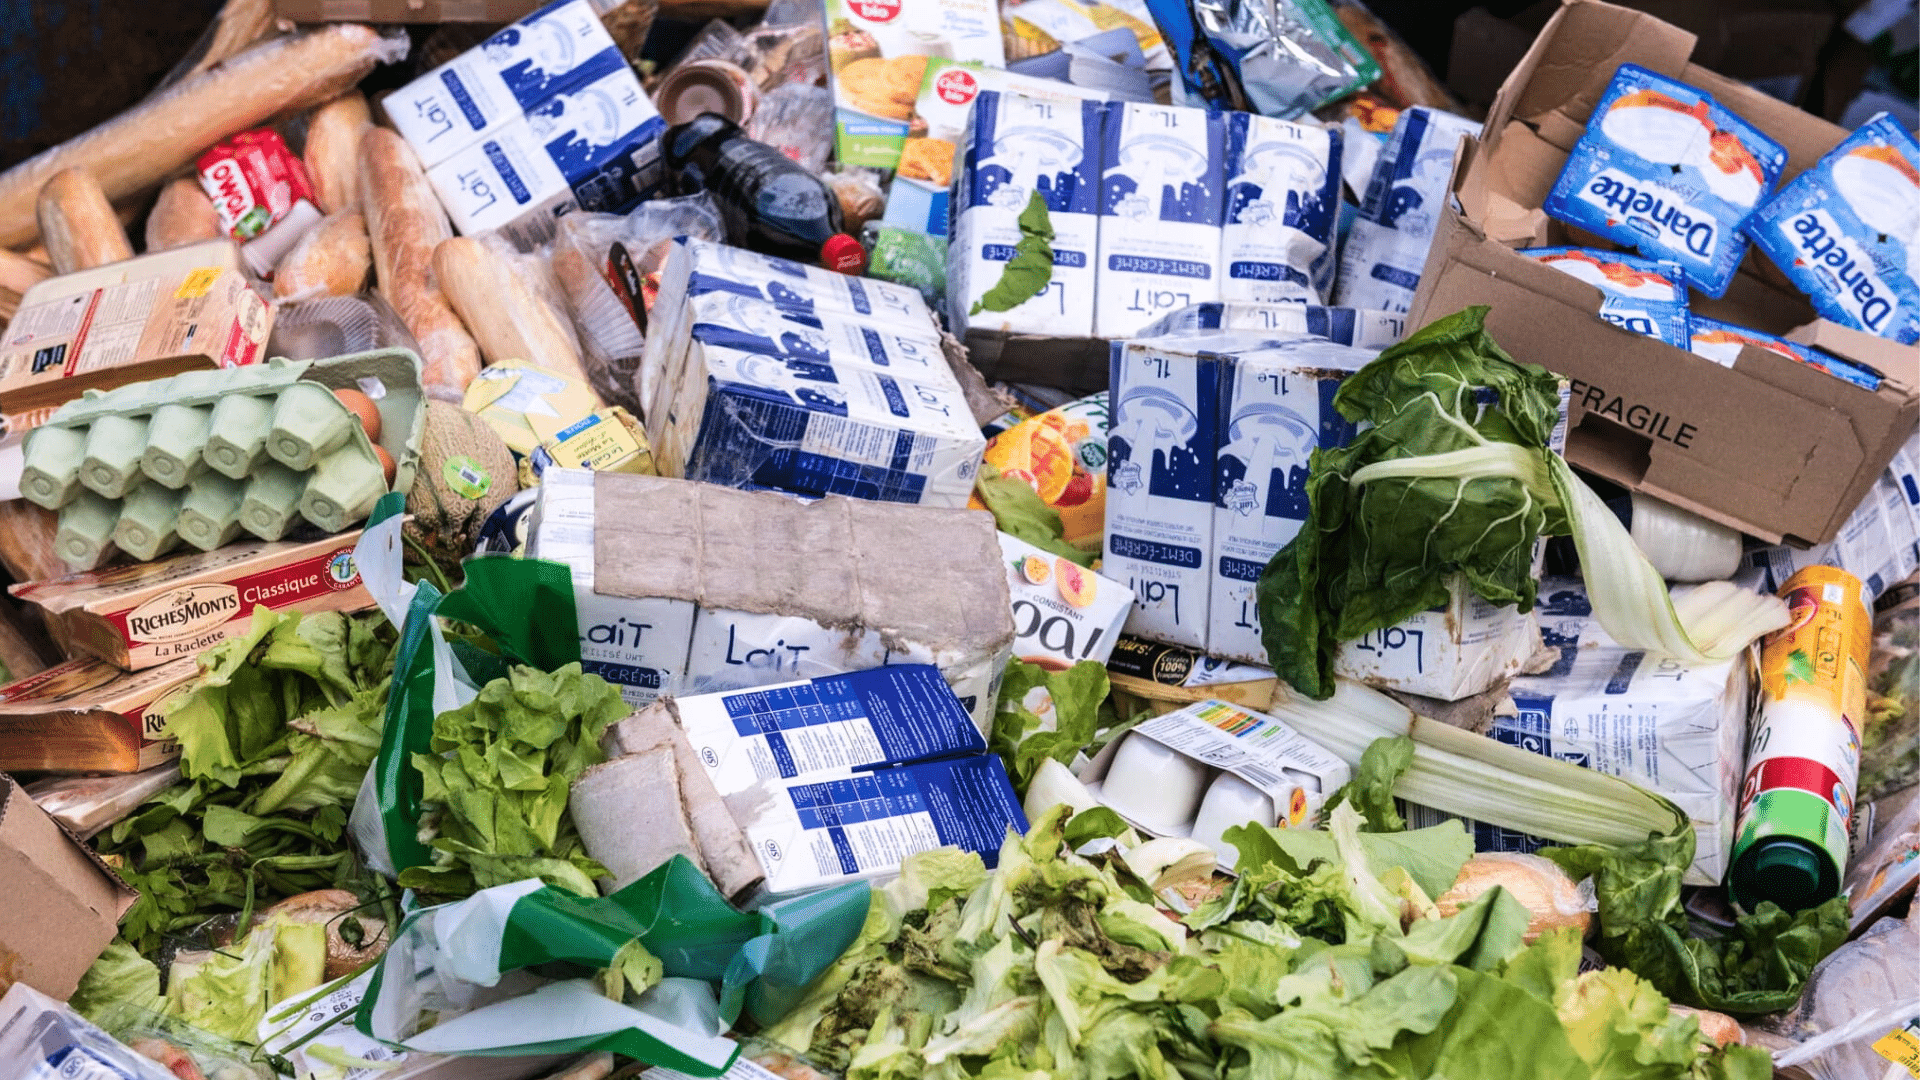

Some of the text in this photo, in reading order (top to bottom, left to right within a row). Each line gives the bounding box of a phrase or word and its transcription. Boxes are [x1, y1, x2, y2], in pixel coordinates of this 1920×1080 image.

[1587, 176, 1716, 261] Danette
[1793, 212, 1893, 336] Danette
[1570, 378, 1699, 450] FRAGILE
[243, 573, 319, 604] Classique
[1033, 594, 1085, 622] CONSISTANT
[155, 645, 170, 658] La
[174, 628, 226, 656] Raclette
[1011, 600, 1105, 662] oa!
[726, 623, 810, 673] LaiT
[1159, 660, 1187, 674] 100%
[703, 750, 718, 766] SIG
[767, 842, 779, 858] SIG
